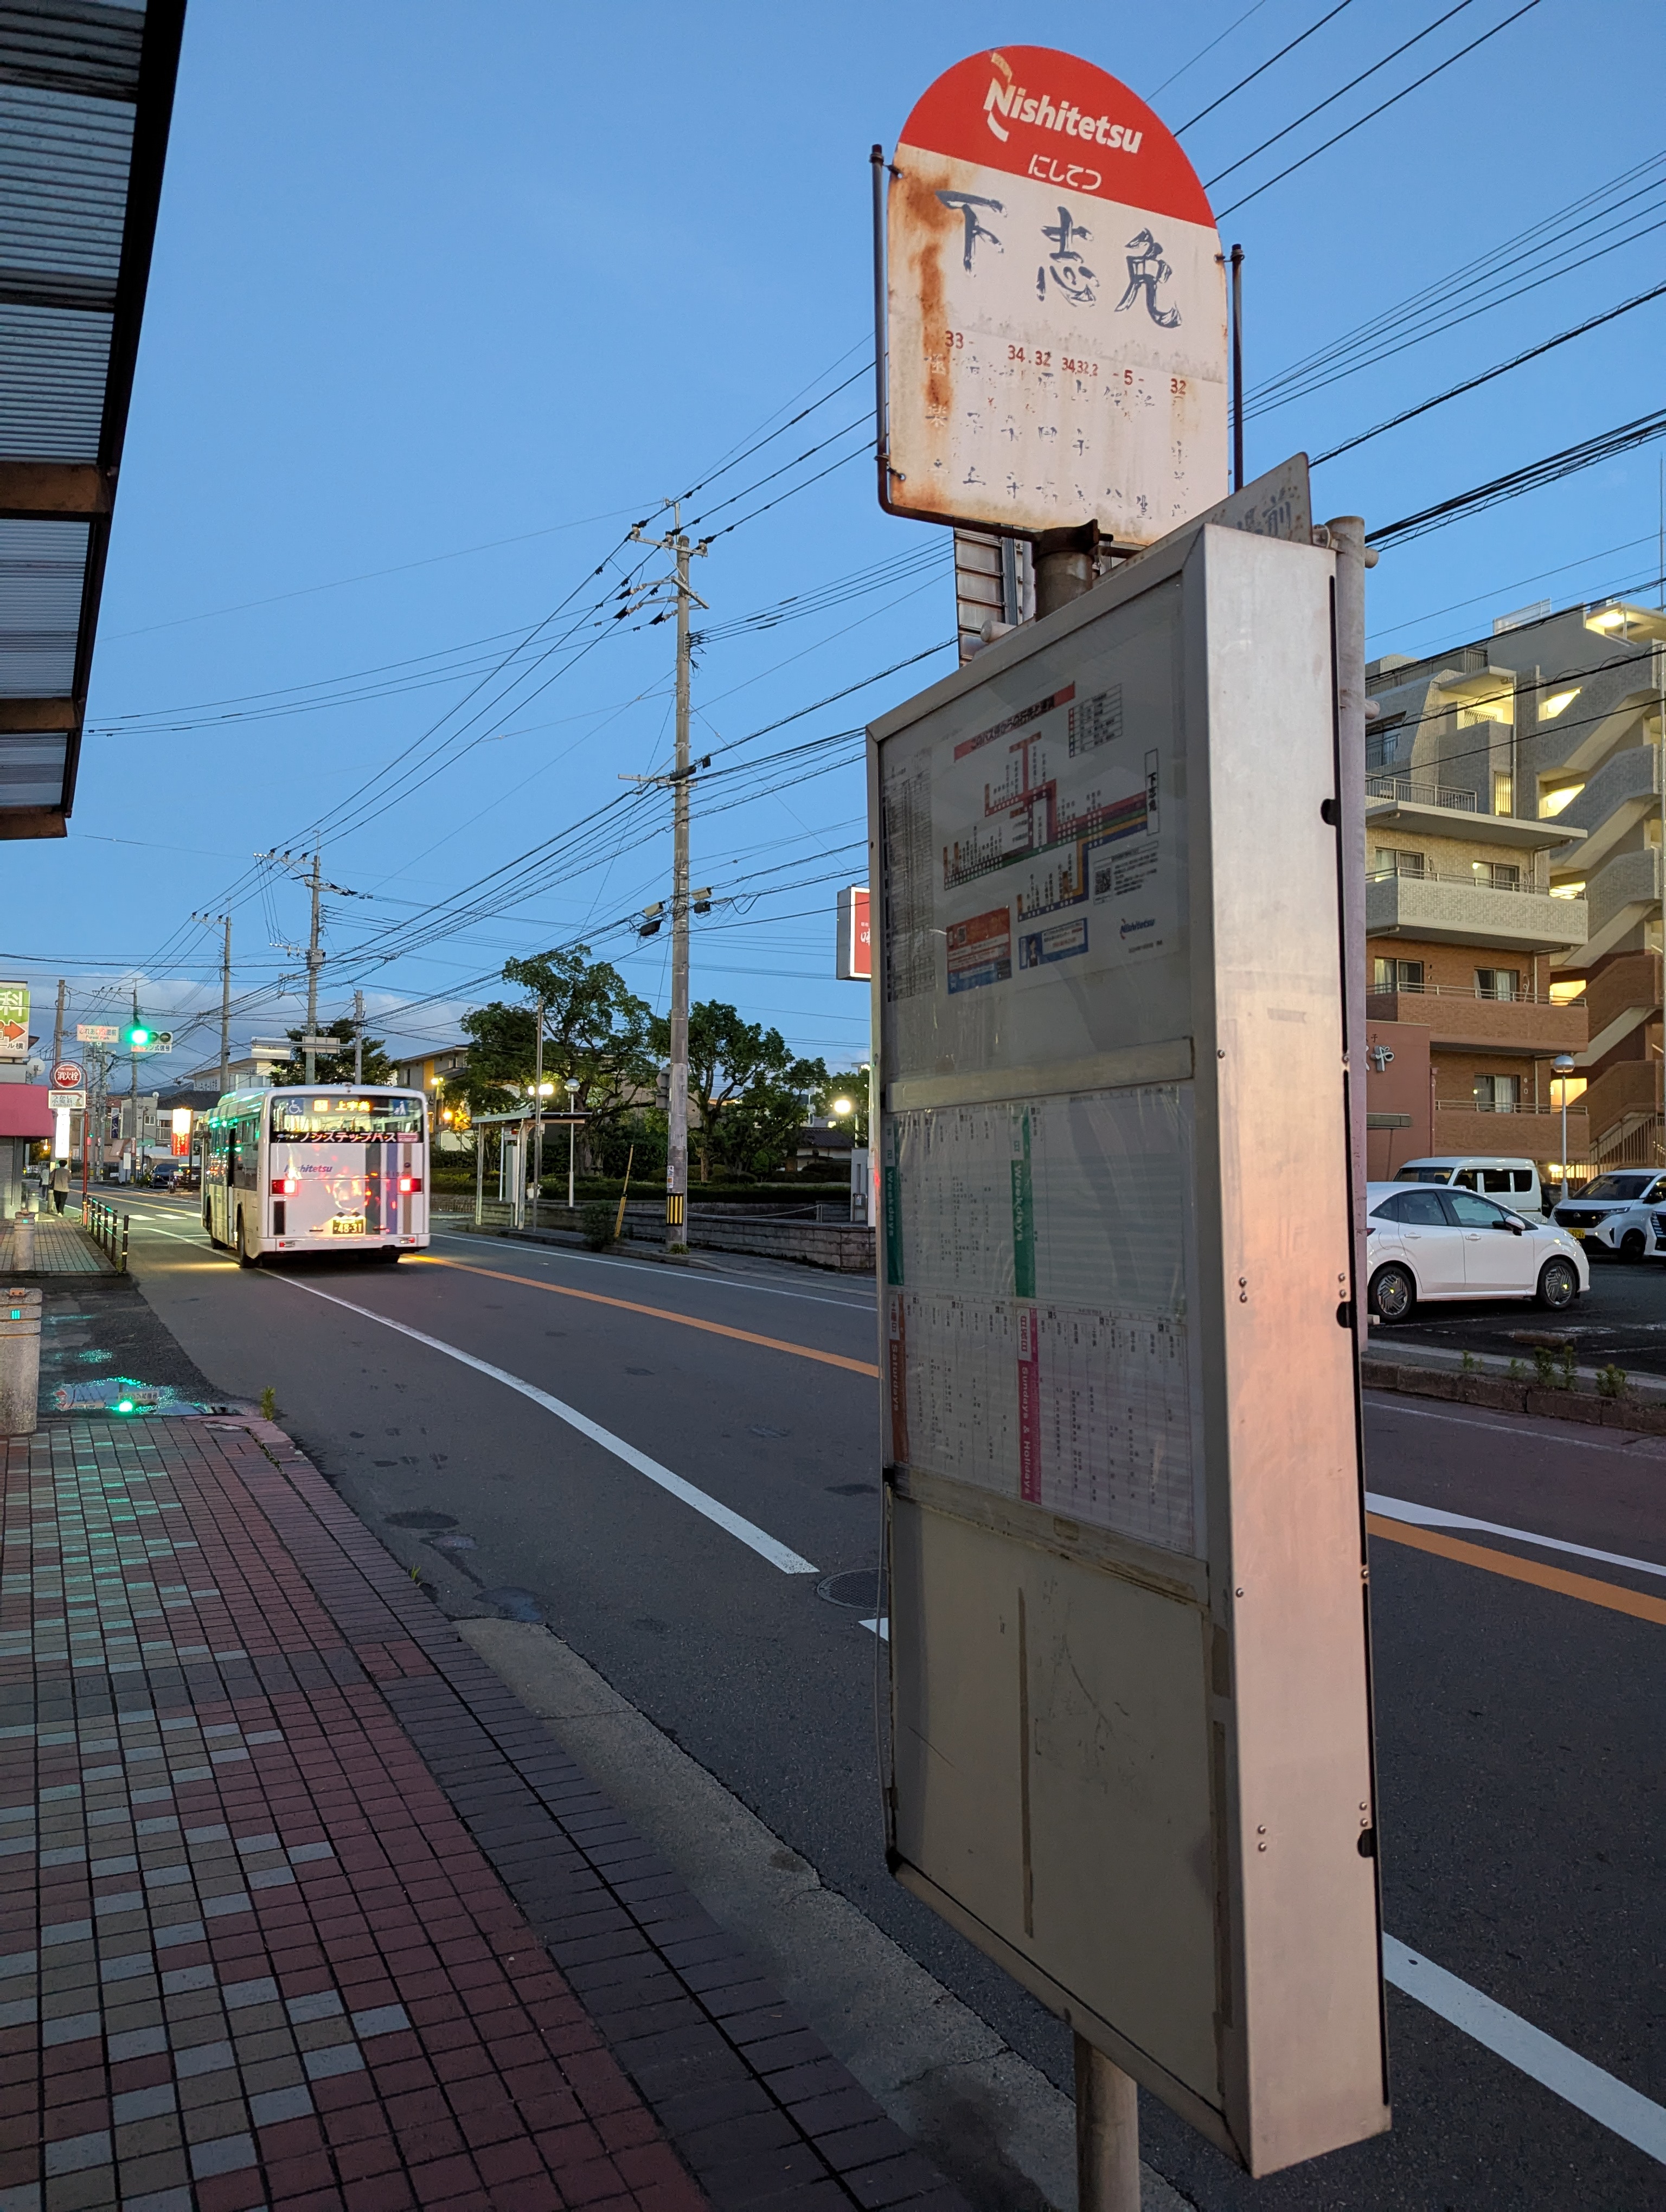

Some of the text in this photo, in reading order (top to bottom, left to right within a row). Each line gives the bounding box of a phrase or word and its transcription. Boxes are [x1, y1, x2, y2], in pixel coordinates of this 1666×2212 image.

[983, 78, 1143, 154] Nishitetsu
[1028, 154, 1102, 191] にしてつ
[935, 190, 1182, 329] 下志免
[945, 330, 963, 349] 33
[1170, 378, 1187, 395] 32
[0, 991, 26, 1017] 科
[57, 1071, 79, 1081] 消火栓
[299, 1131, 397, 1143] ノンステップバス
[1014, 1165, 1023, 1241] Weekdays
[891, 1343, 899, 1411] Saturdays
[1023, 1440, 1031, 1494] Holidays
